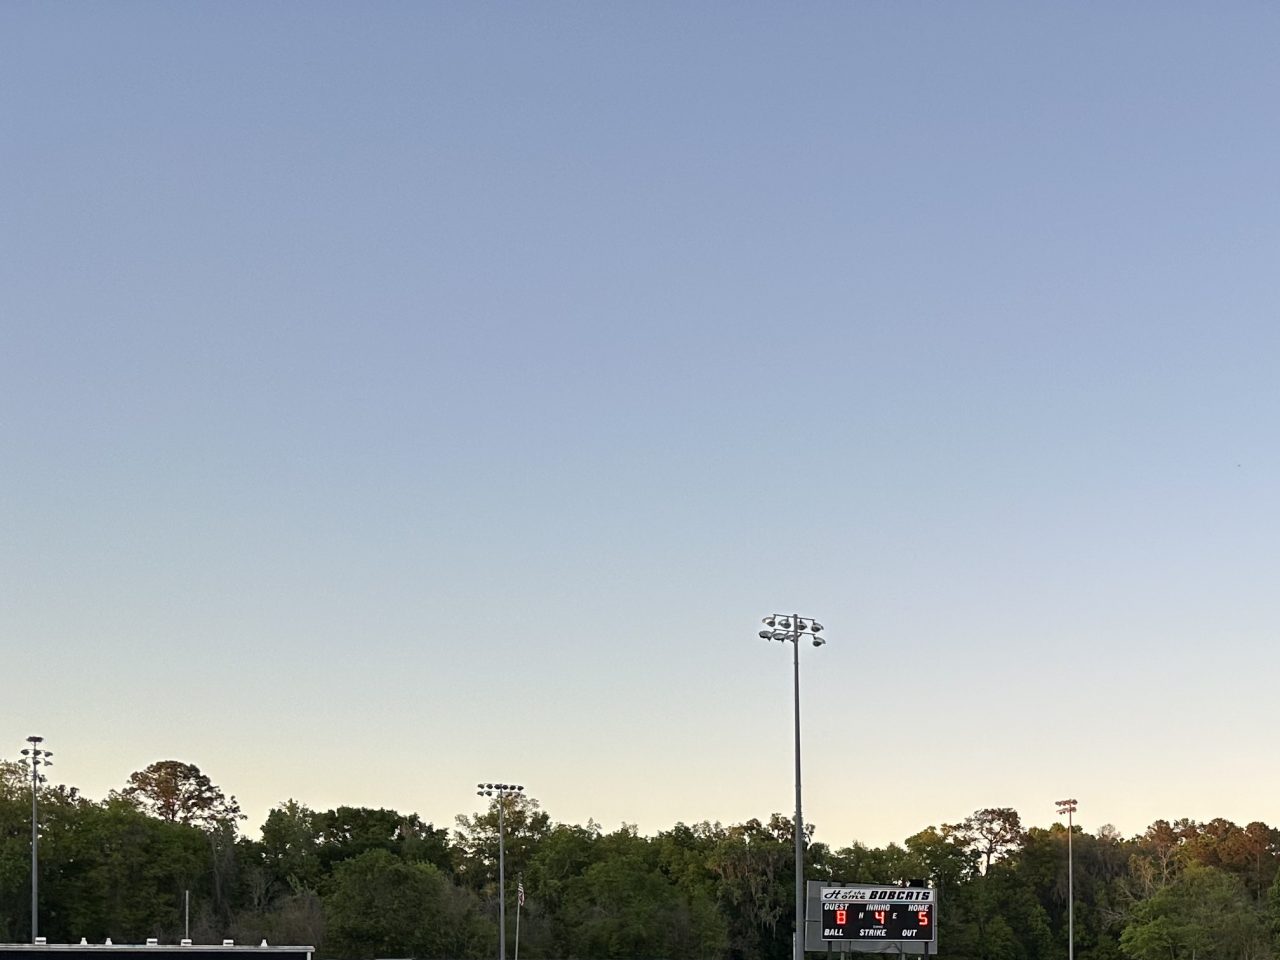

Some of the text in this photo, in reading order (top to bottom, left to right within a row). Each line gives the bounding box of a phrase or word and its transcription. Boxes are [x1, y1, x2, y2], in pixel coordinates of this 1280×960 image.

[869, 890, 930, 900] BOBCATS
[836, 911, 846, 924] 8
[875, 912, 885, 924] 4
[918, 912, 928, 925] 5
